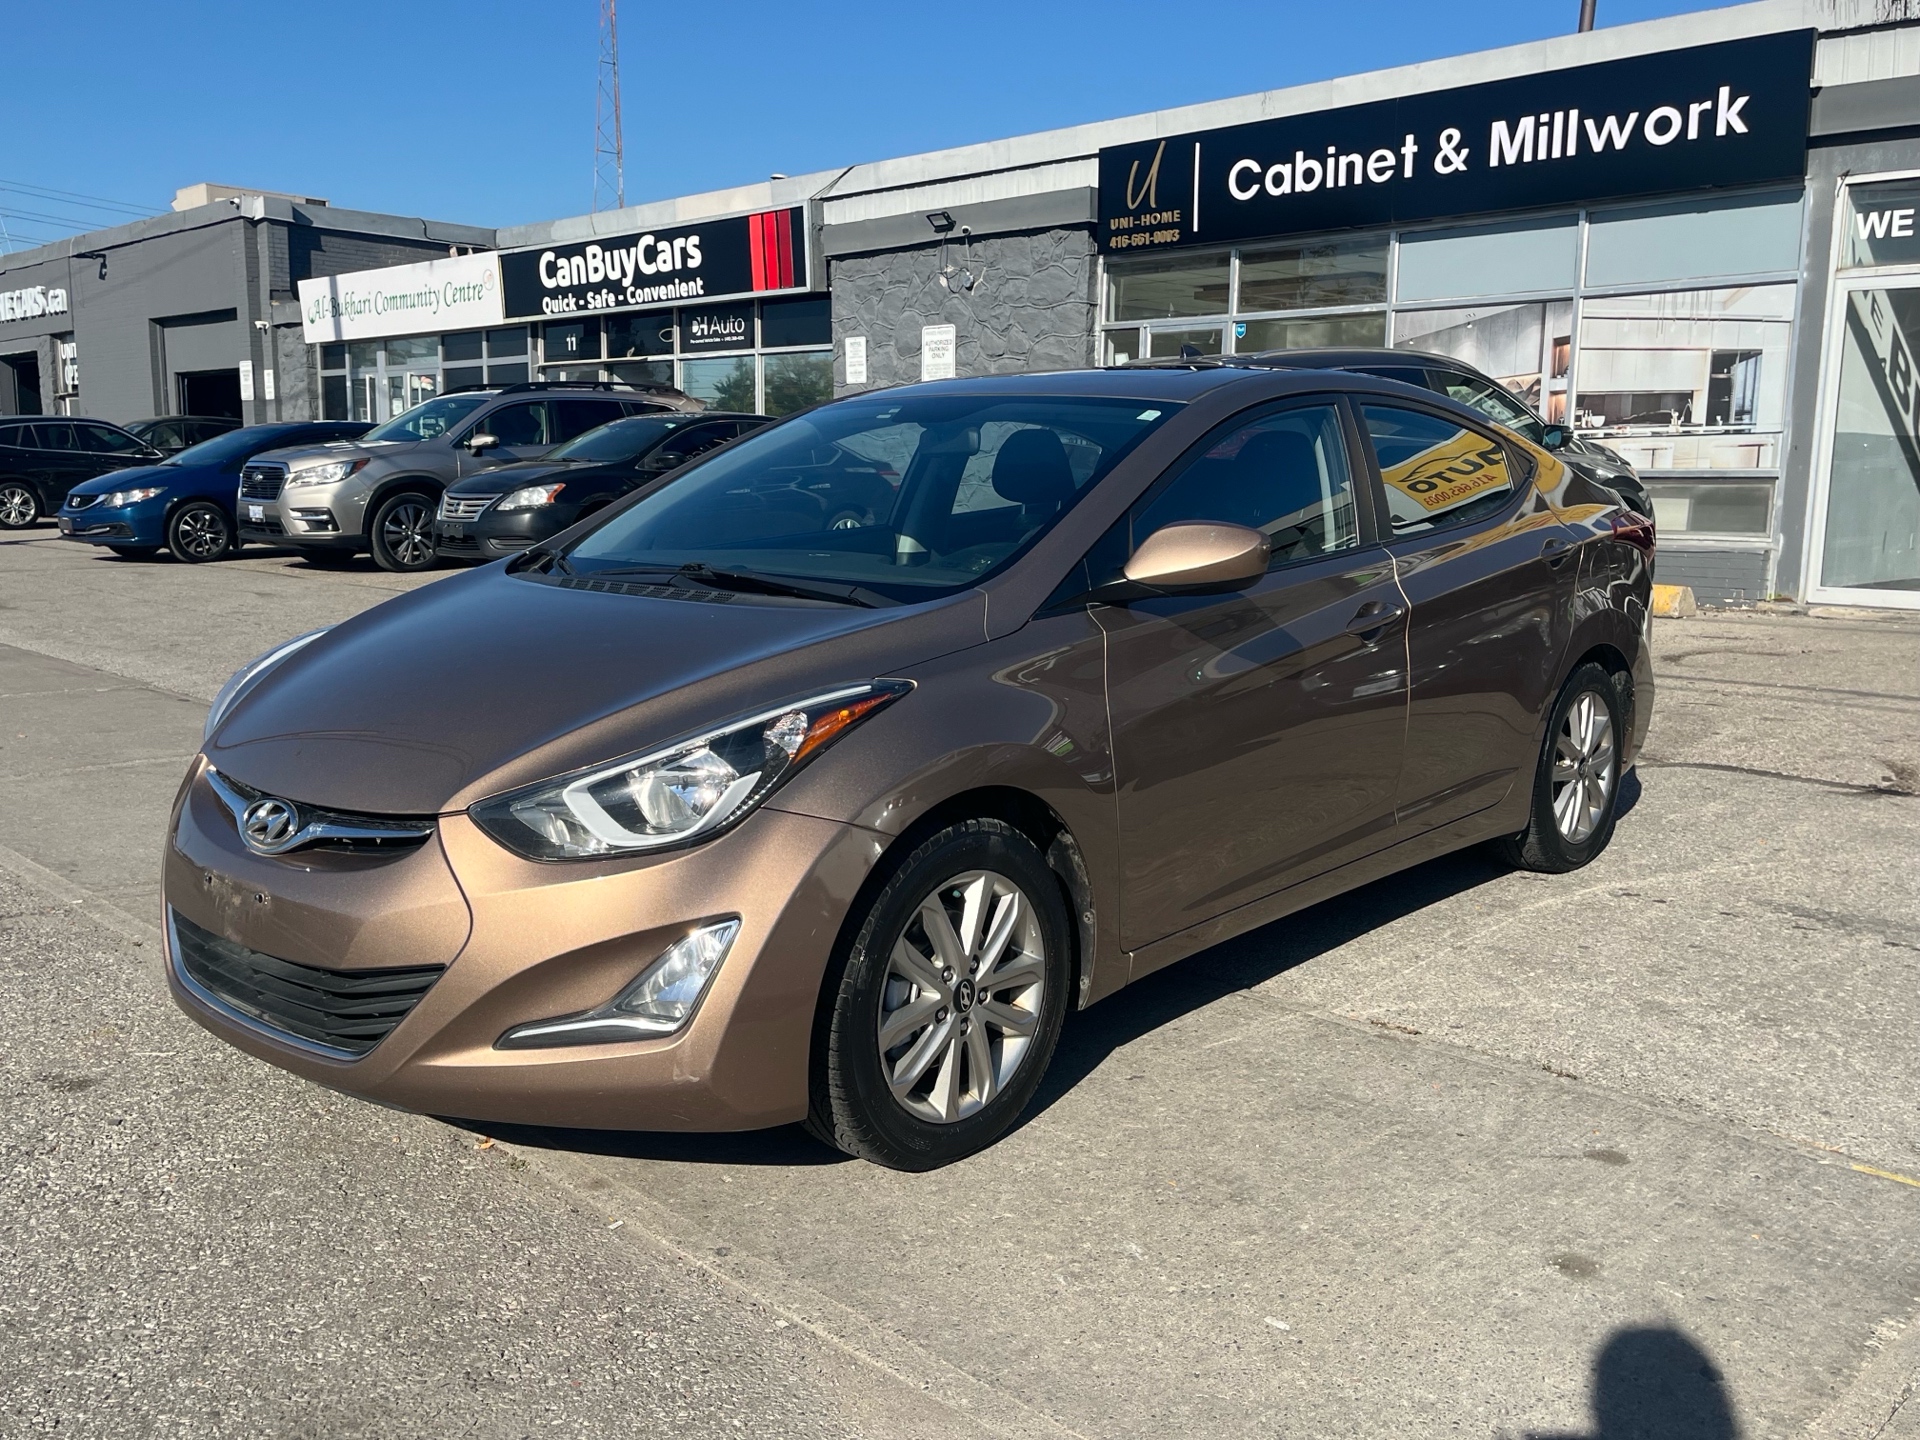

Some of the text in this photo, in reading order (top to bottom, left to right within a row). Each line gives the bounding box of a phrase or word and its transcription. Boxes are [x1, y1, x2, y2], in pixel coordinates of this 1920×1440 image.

[1227, 85, 1751, 201] Cabinet & Millwork
[1109, 210, 1181, 230] UNI-HOME
[1856, 208, 1915, 240] WE
[539, 234, 702, 289] CanBuyCars
[313, 281, 484, 321] Al-Bukhari Community Centre
[542, 293, 577, 315] Quick
[586, 288, 616, 309] Safe
[626, 277, 704, 304] Convenient
[709, 315, 745, 335] Auto
[566, 334, 577, 351] 11
[925, 338, 953, 347] AUTHORIZED
[931, 351, 945, 359] ONLY
